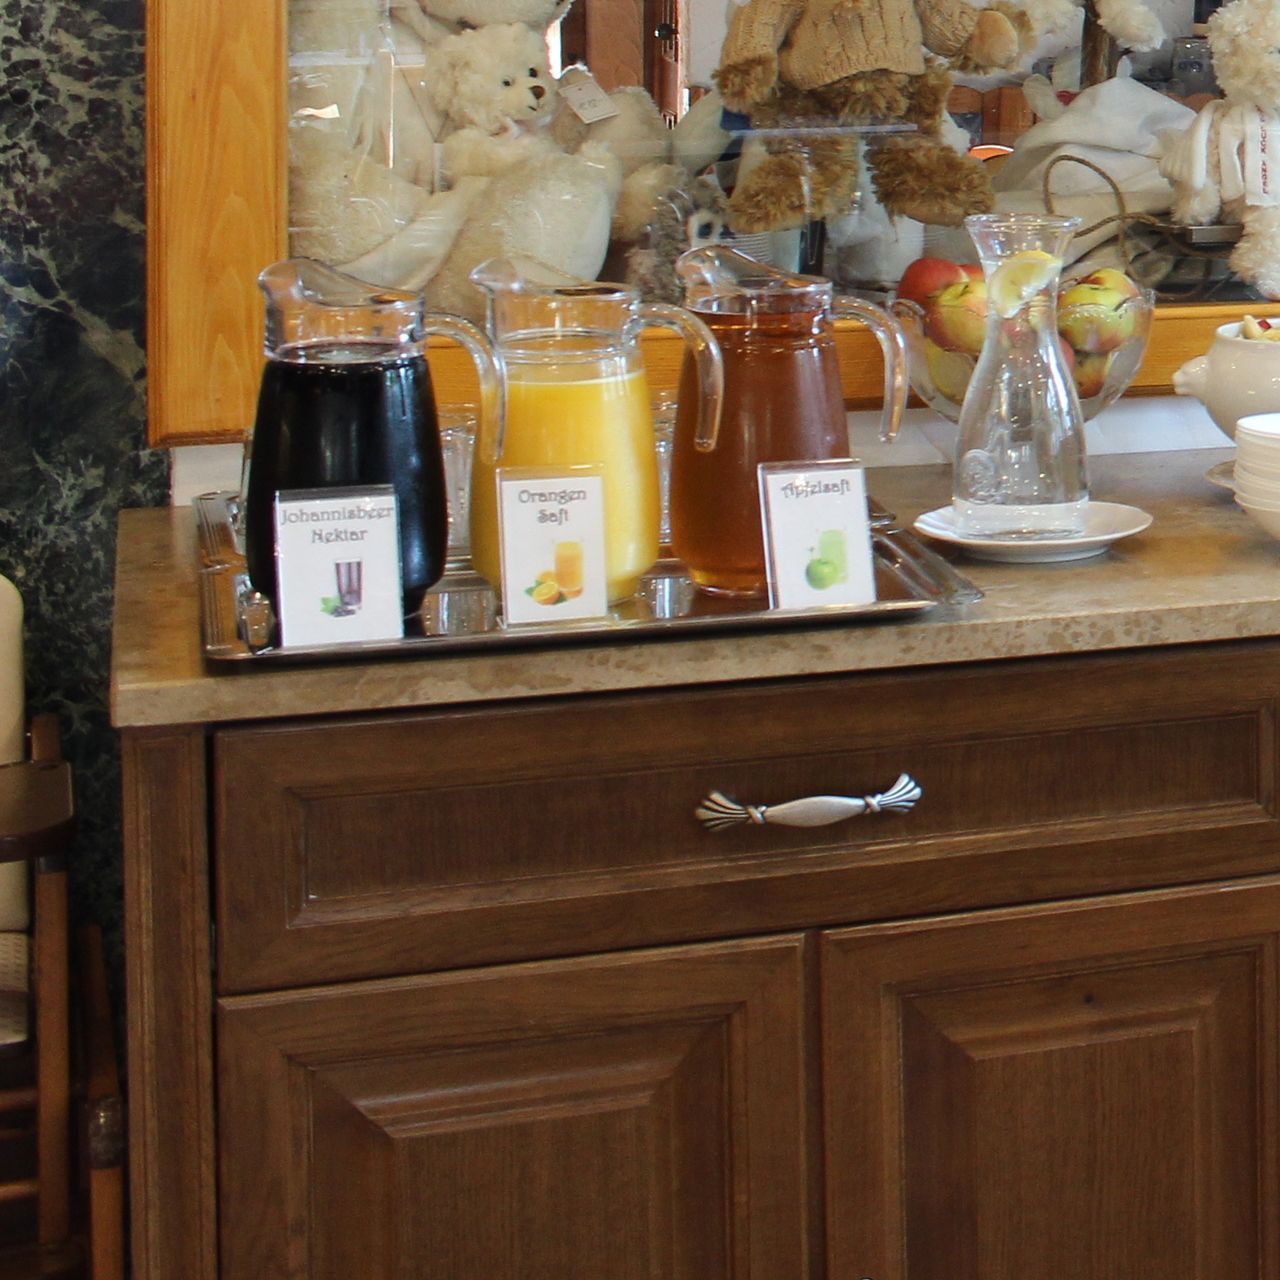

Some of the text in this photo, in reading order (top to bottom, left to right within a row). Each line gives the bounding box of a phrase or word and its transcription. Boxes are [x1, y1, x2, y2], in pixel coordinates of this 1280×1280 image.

[781, 478, 851, 498] Apfelsaft
[518, 489, 587, 505] Orangen
[280, 506, 394, 525] Johannisbeer
[537, 508, 569, 525] Saft
[311, 528, 368, 543] Nektar
